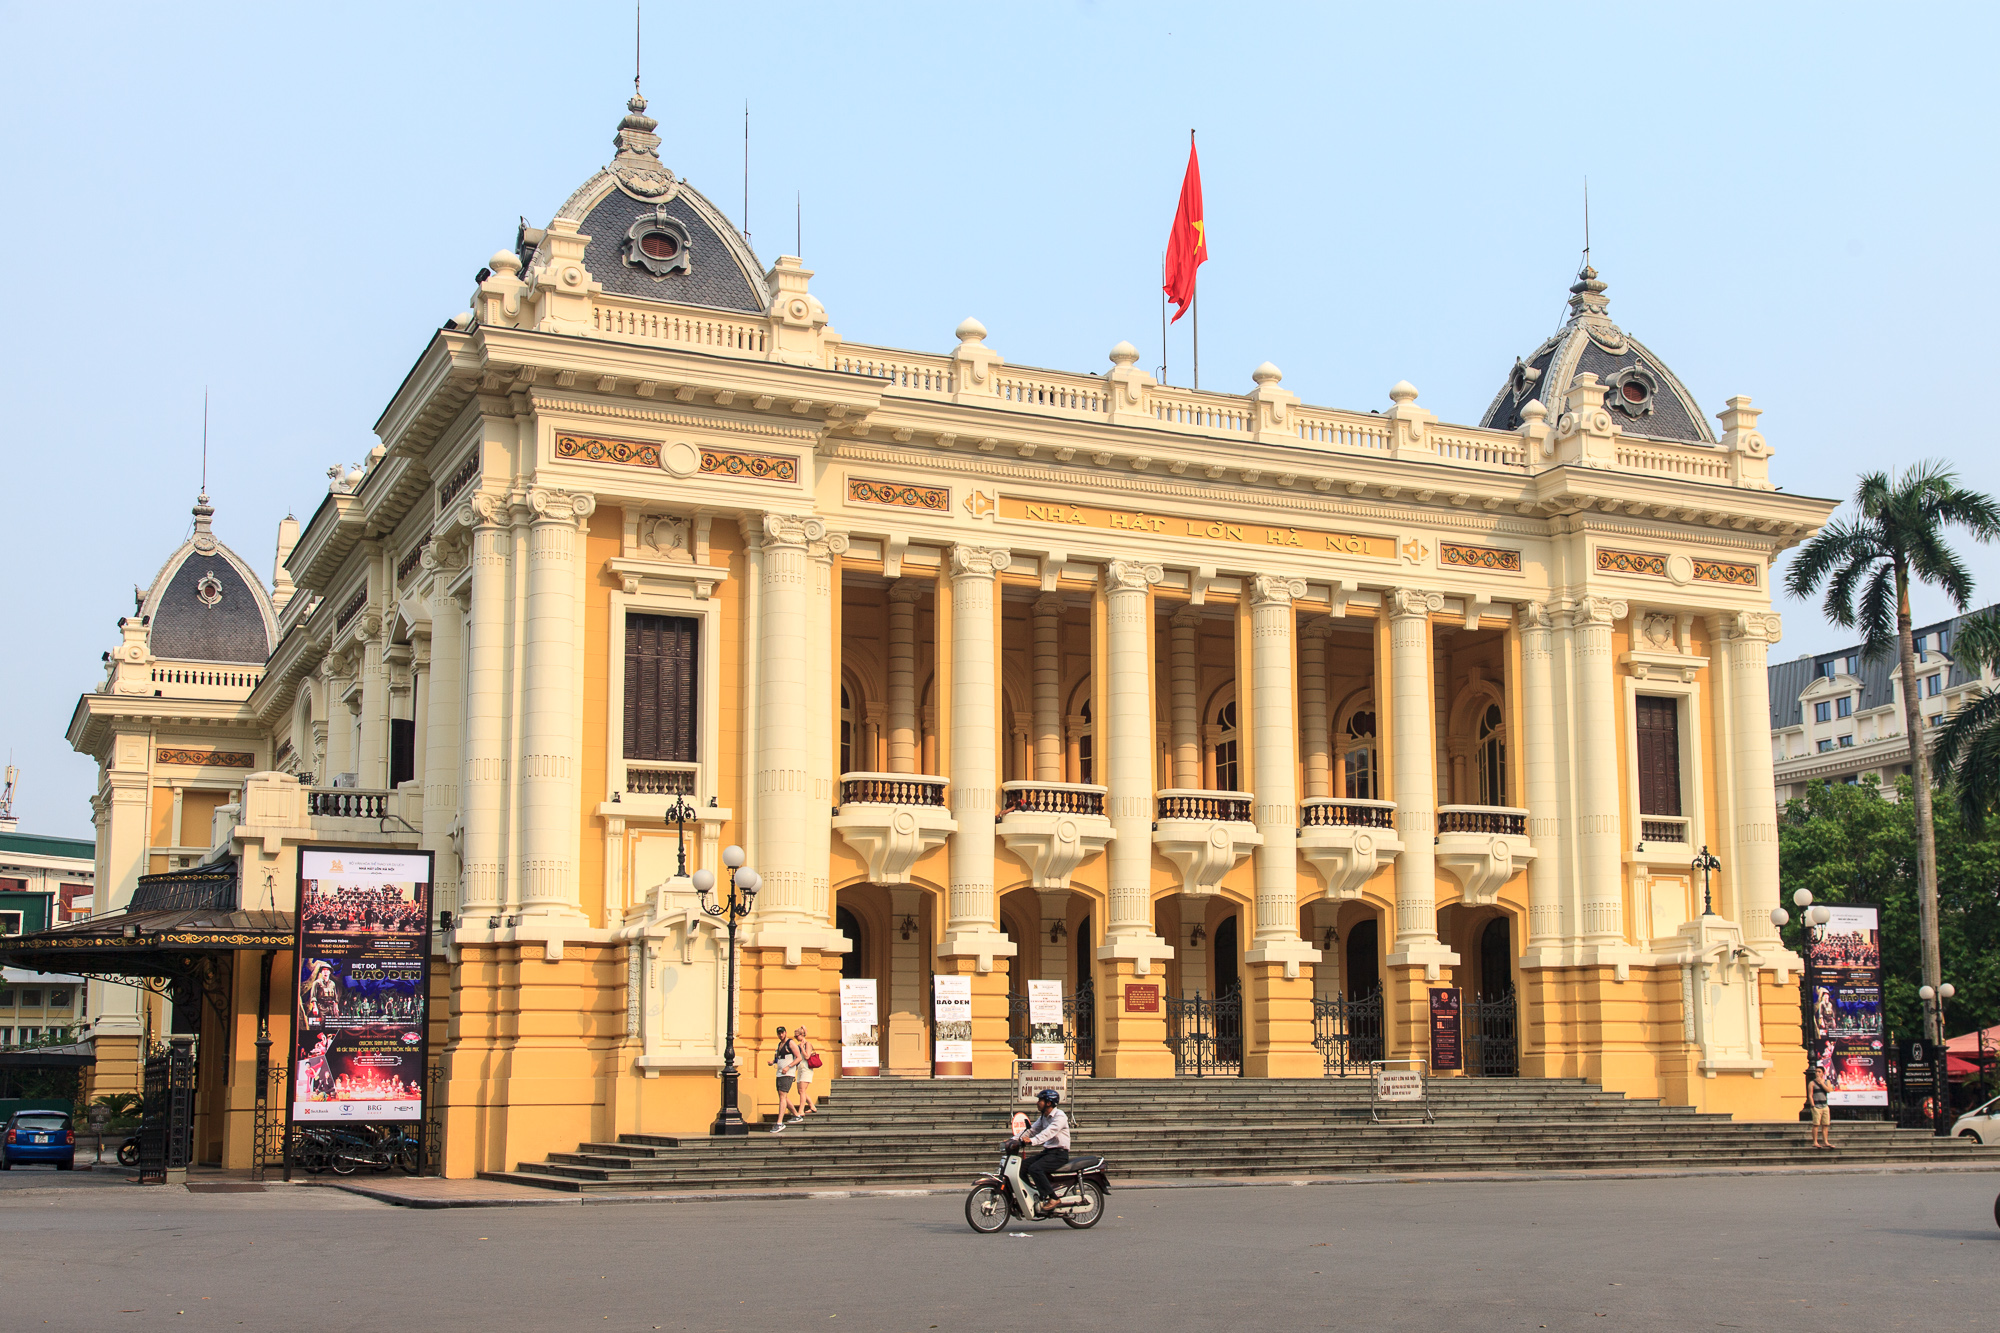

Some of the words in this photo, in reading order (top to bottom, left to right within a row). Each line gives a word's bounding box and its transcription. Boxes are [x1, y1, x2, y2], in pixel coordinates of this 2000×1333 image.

[1026, 503, 1086, 524] NHÀ
[1109, 511, 1165, 532] HÁT
[1267, 527, 1303, 547] HÀ
[1325, 534, 1372, 555] NỘI
[388, 970, 422, 980] ĐEN
